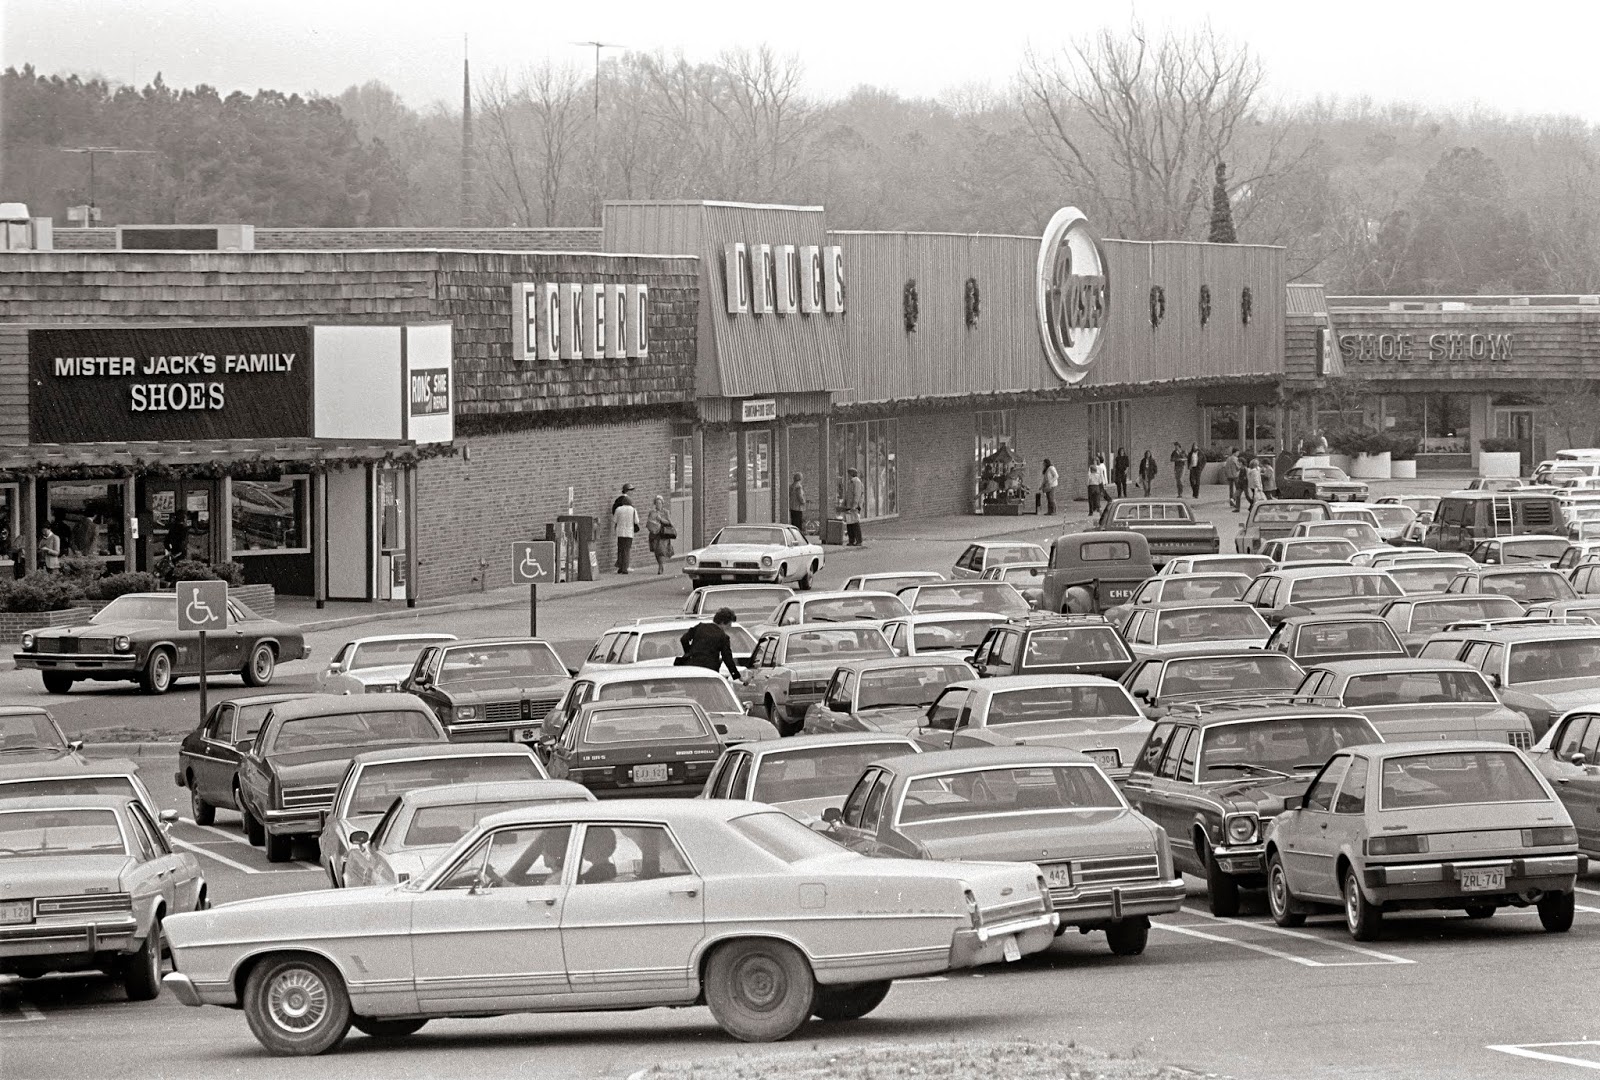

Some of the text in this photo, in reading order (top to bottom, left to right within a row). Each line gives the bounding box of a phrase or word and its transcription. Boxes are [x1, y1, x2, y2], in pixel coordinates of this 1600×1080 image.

[738, 250, 845, 307] DRUGS
[525, 291, 647, 353] ECKERD
[1339, 333, 1415, 361] SHOE
[1429, 333, 1514, 361] SHOW
[54, 353, 296, 376] MISTER JACK'S FAMILY
[131, 382, 225, 411] SHOES
[411, 371, 431, 403] RON'S
[1463, 873, 1504, 887] ZRL-747
